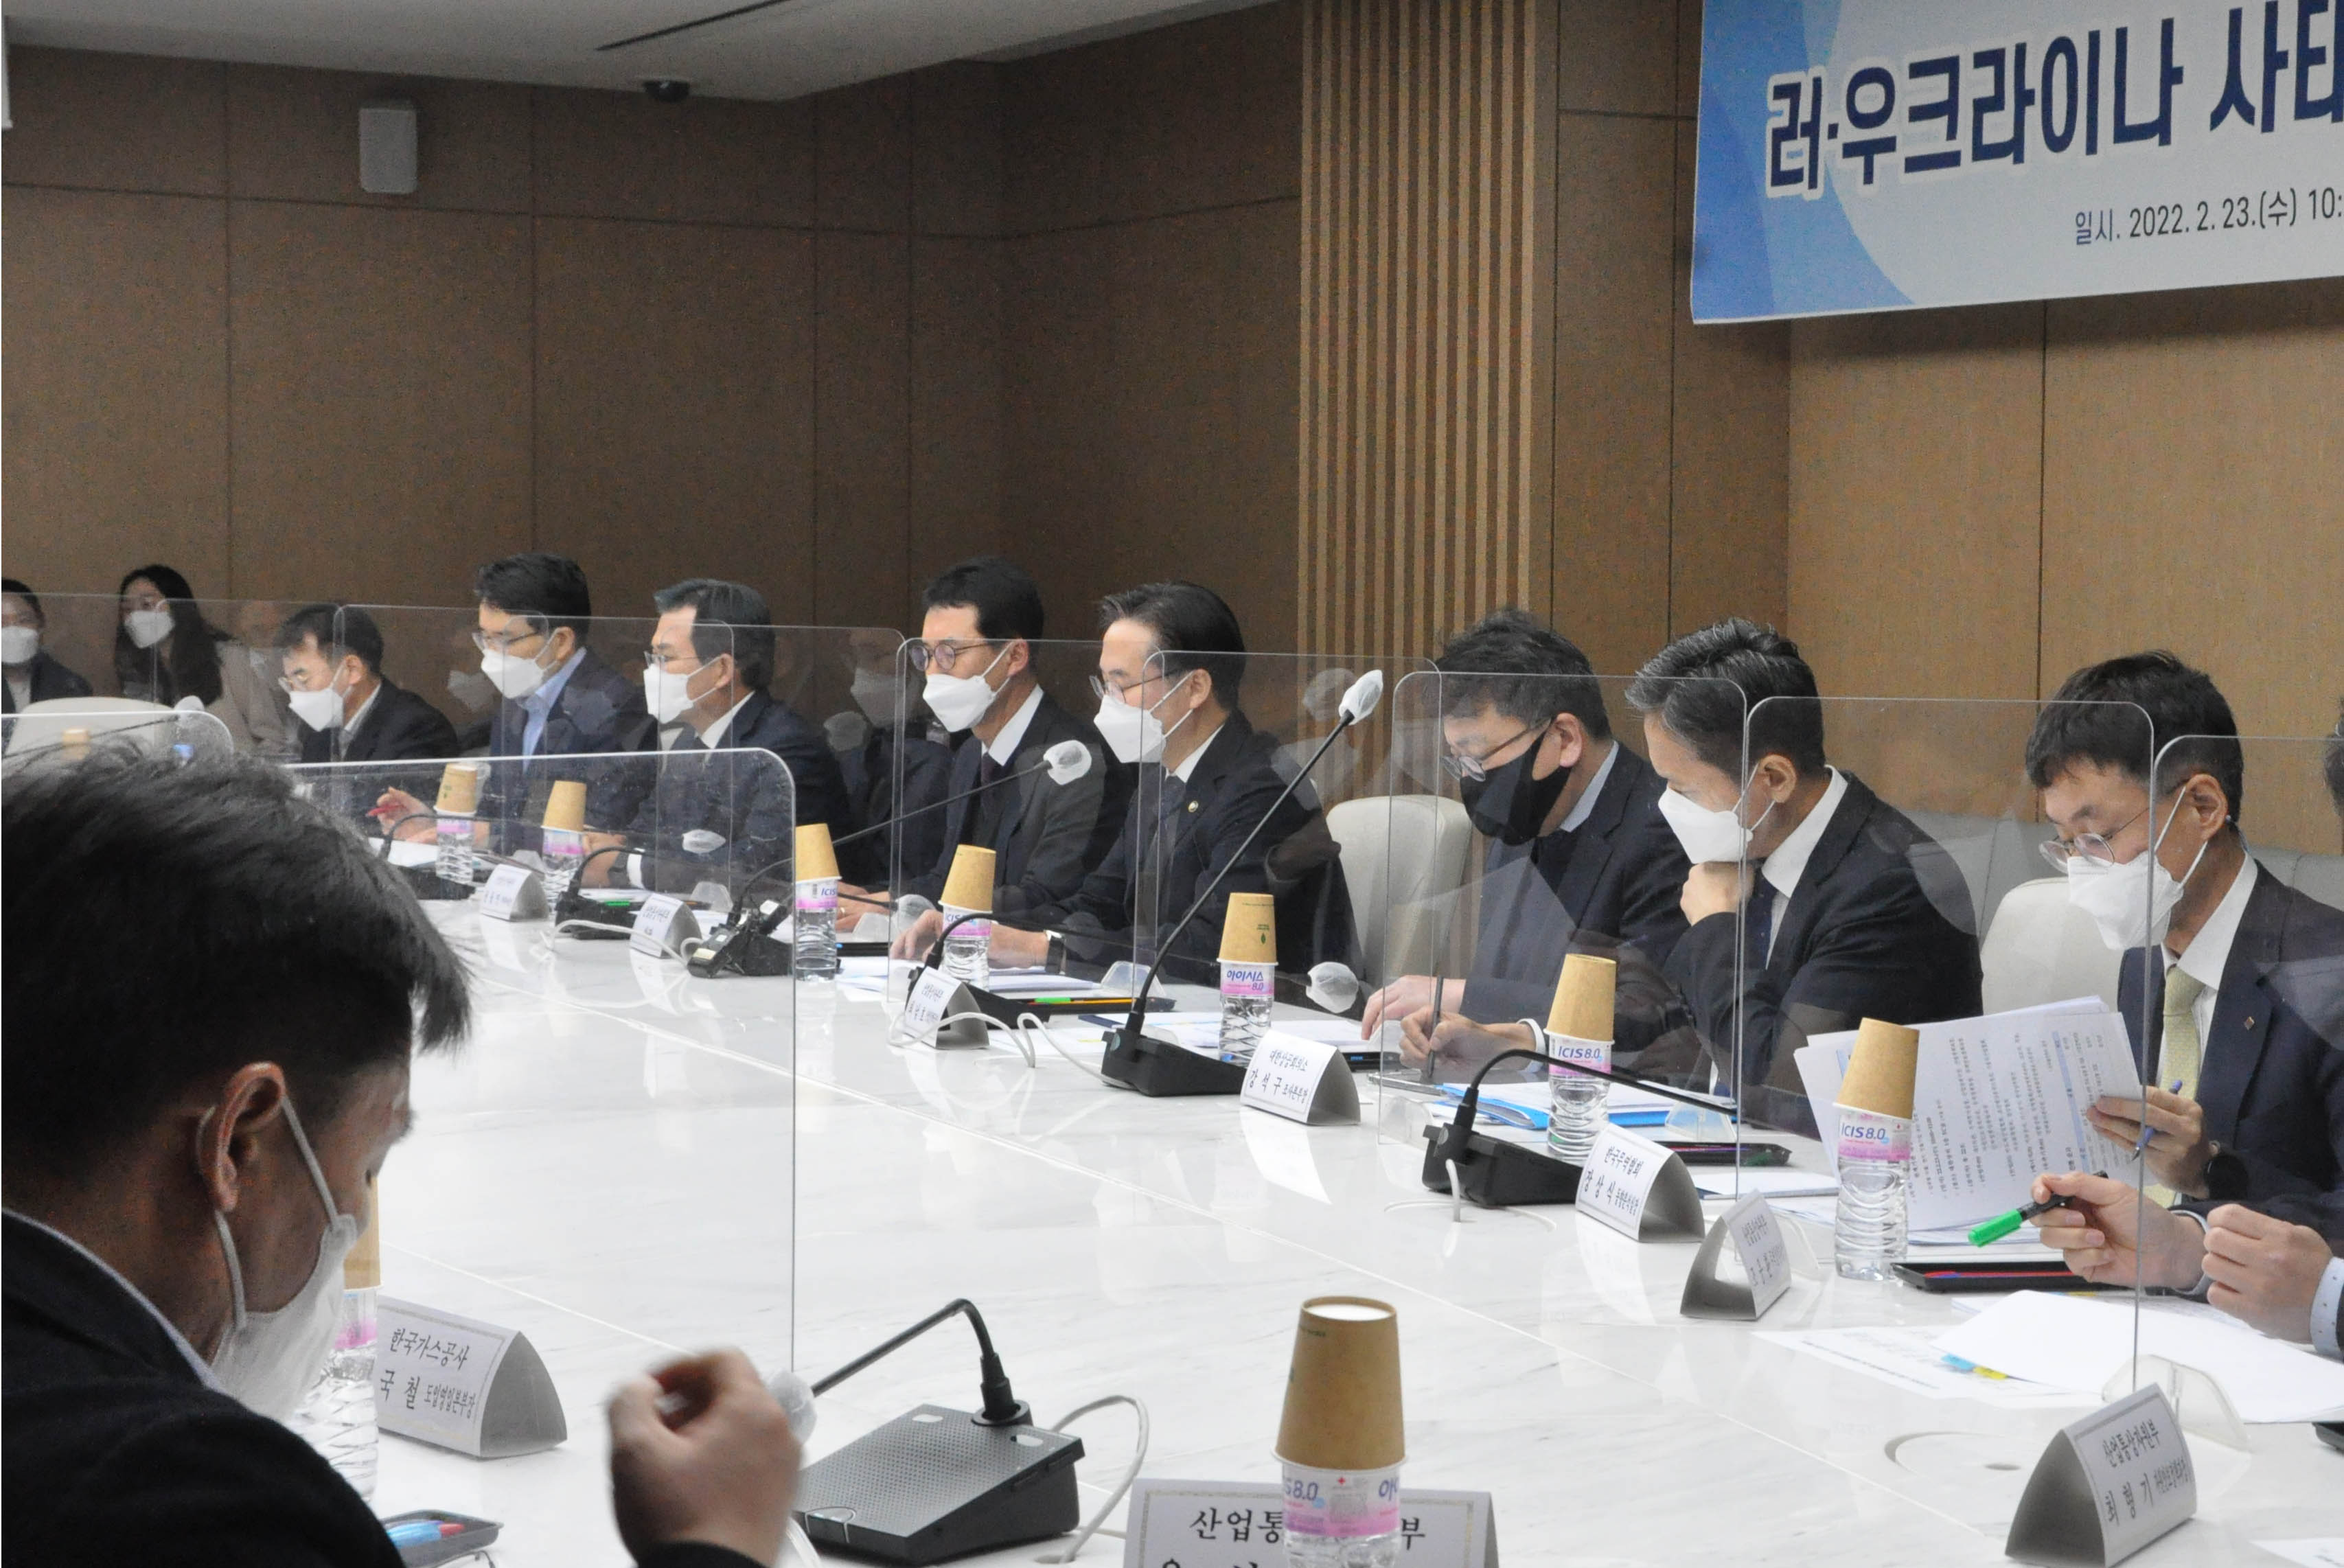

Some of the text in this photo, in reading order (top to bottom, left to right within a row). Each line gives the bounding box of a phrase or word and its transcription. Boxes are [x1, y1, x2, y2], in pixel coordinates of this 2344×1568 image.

[1771, 17, 2184, 190] 러·우크라이나
[2076, 208, 2120, 245] 일시.
[2130, 203, 2189, 238] 2022.
[2196, 200, 2215, 231] 2.
[1269, 1049, 1308, 1072] 대한상공회의소
[1605, 1146, 1645, 1179] 한국무역협회
[390, 1328, 470, 1372] 한국가스공사
[2102, 1418, 2162, 1468] 산업통상자원부
